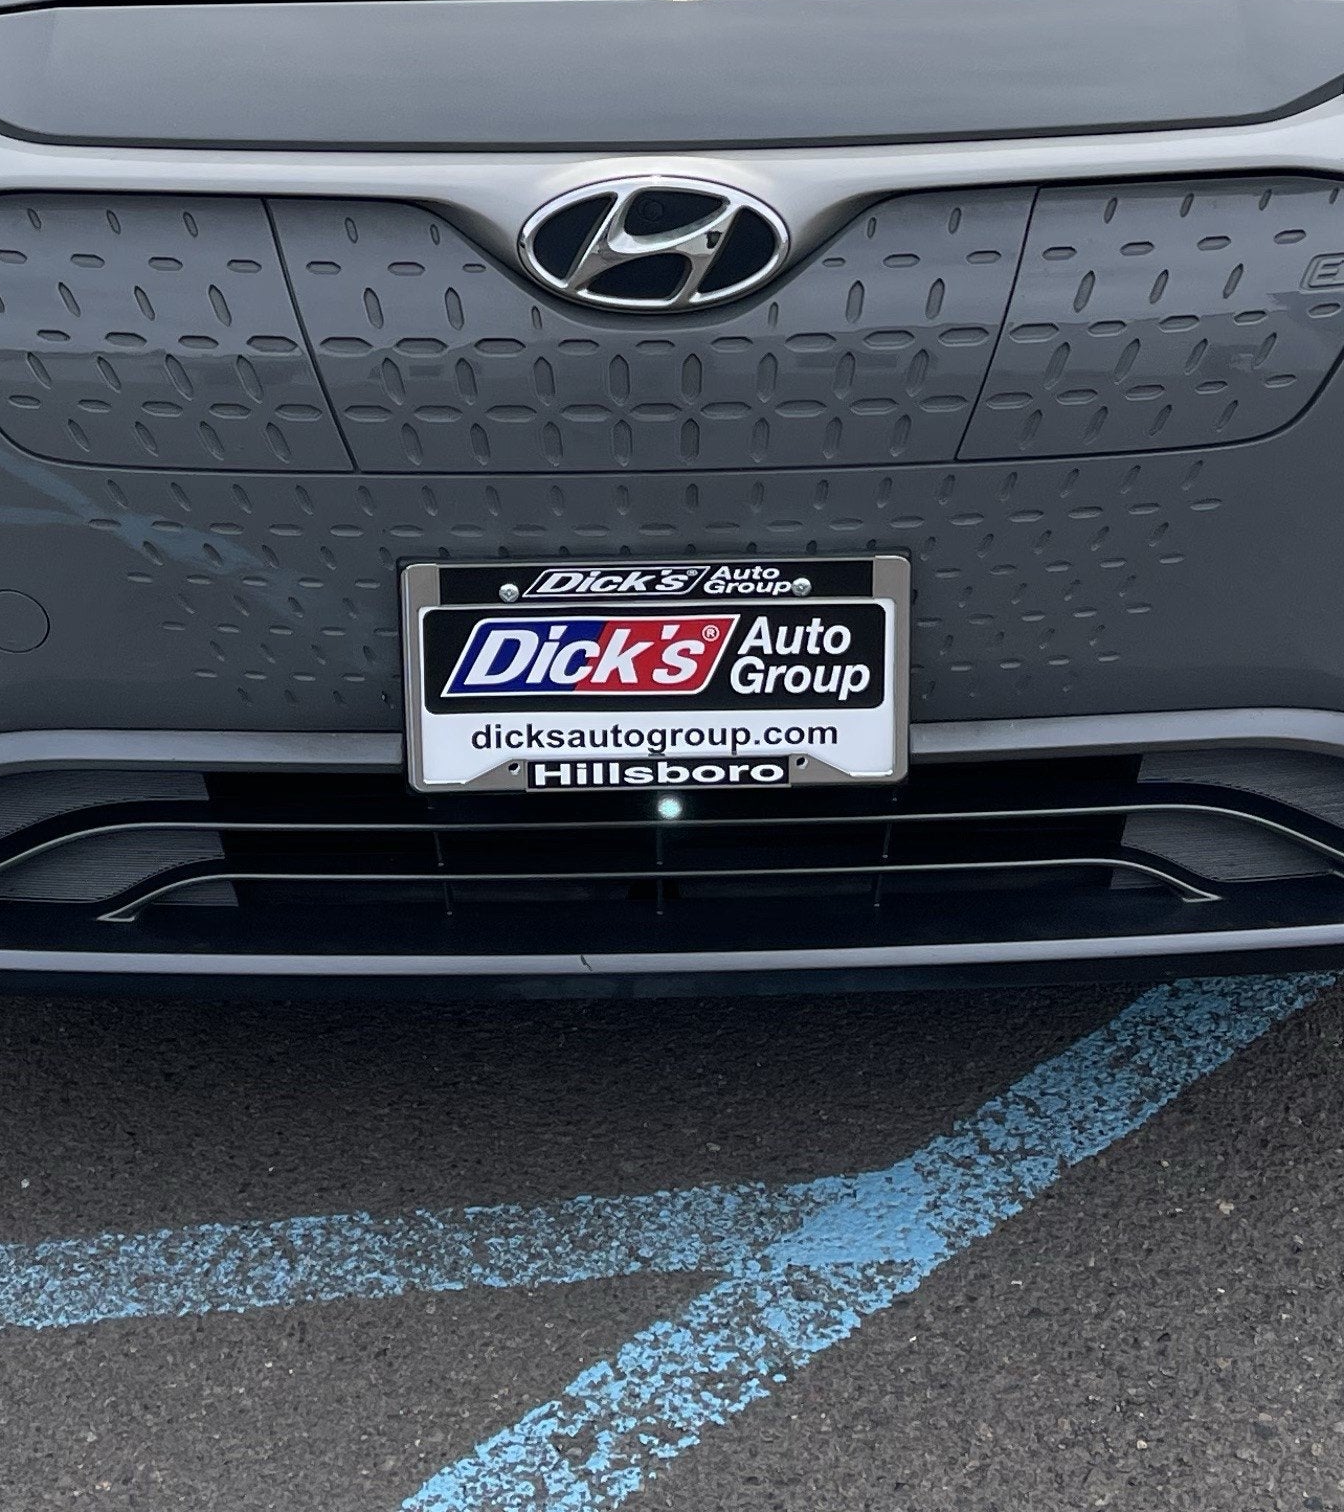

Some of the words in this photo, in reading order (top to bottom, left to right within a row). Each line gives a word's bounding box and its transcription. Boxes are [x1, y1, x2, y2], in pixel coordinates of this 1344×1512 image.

[710, 565, 781, 580] Auto
[703, 579, 793, 596] Group
[738, 615, 851, 656] Auto
[729, 656, 871, 701] Group
[471, 724, 838, 756] dicksautogroup.com
[534, 761, 785, 786] Hillsboro
